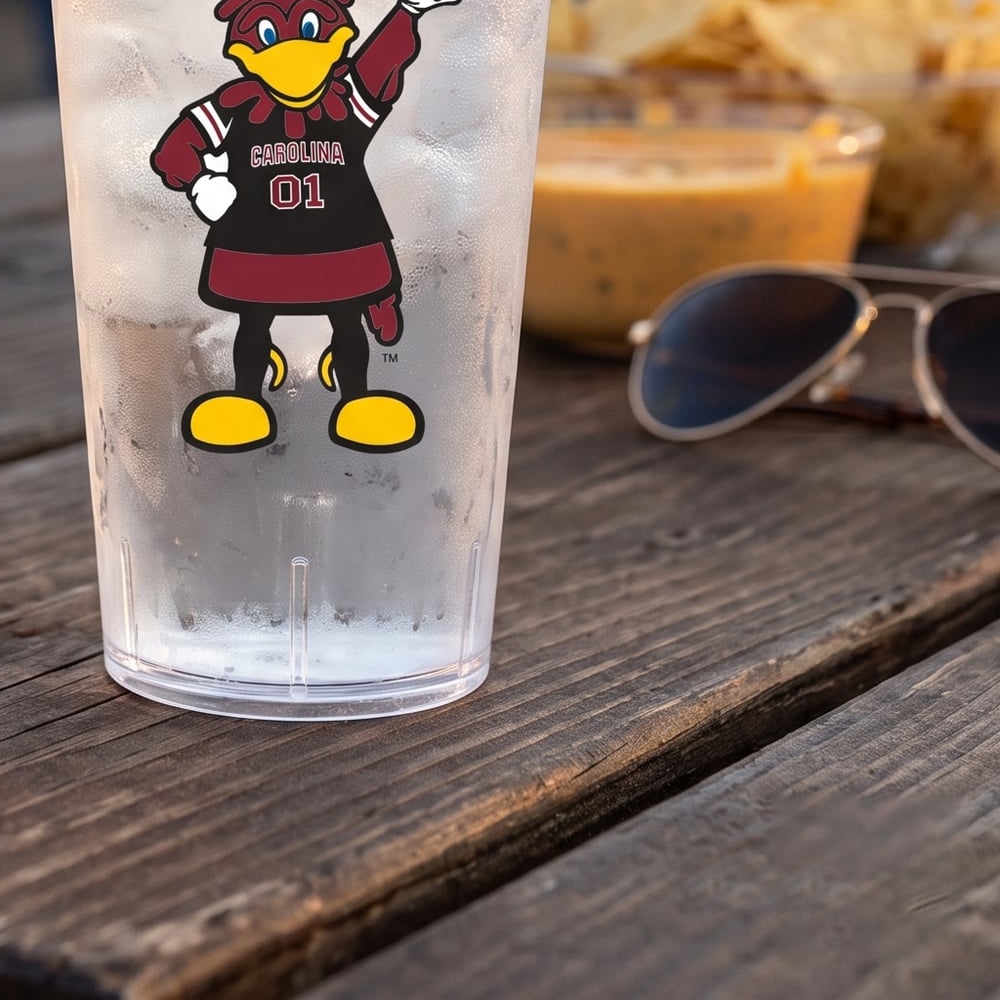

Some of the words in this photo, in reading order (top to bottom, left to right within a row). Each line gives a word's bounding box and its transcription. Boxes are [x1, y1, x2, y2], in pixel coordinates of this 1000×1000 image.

[250, 141, 345, 167] CAROLINA
[270, 173, 325, 209] 01
[382, 353, 399, 363] TM
